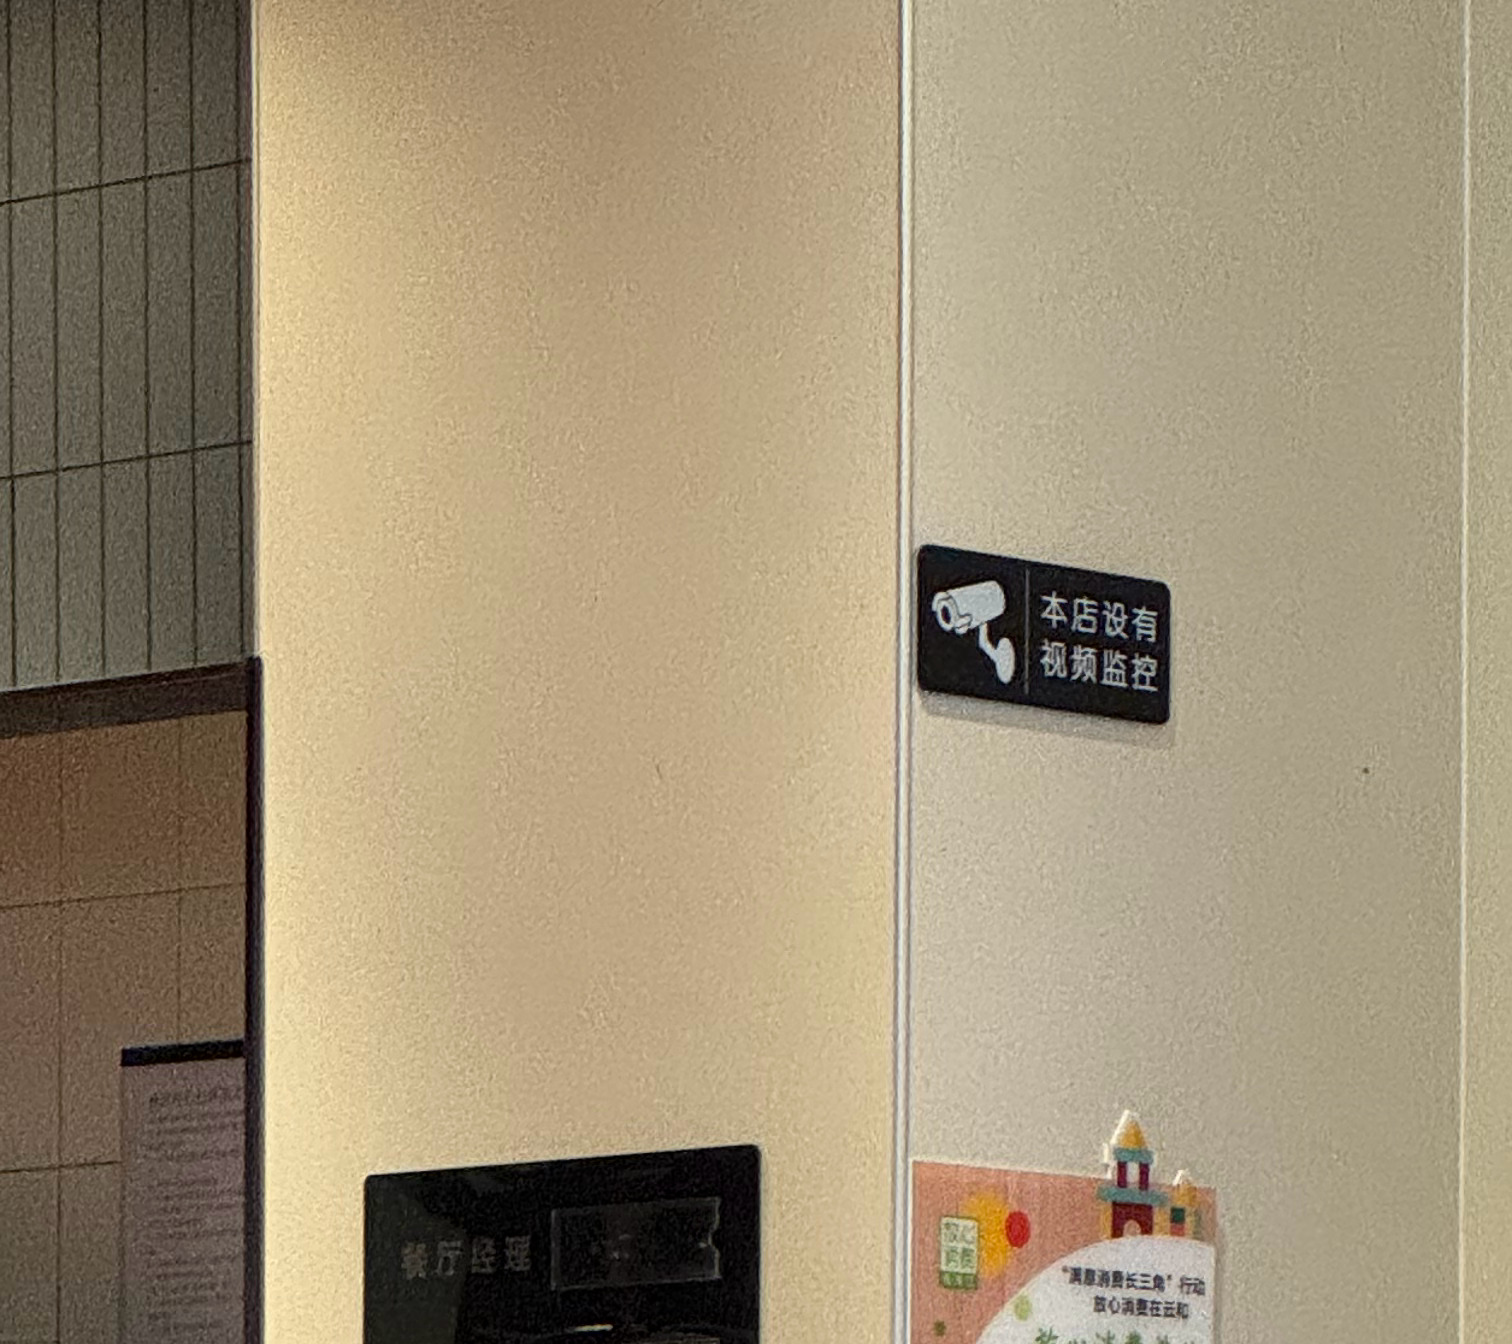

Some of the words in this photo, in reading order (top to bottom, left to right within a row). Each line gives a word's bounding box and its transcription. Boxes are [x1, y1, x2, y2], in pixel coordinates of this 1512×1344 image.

[1040, 591, 1159, 643] 本店设有
[1040, 639, 1159, 692] 视频监控
[401, 1236, 531, 1280] 餐厅经理
